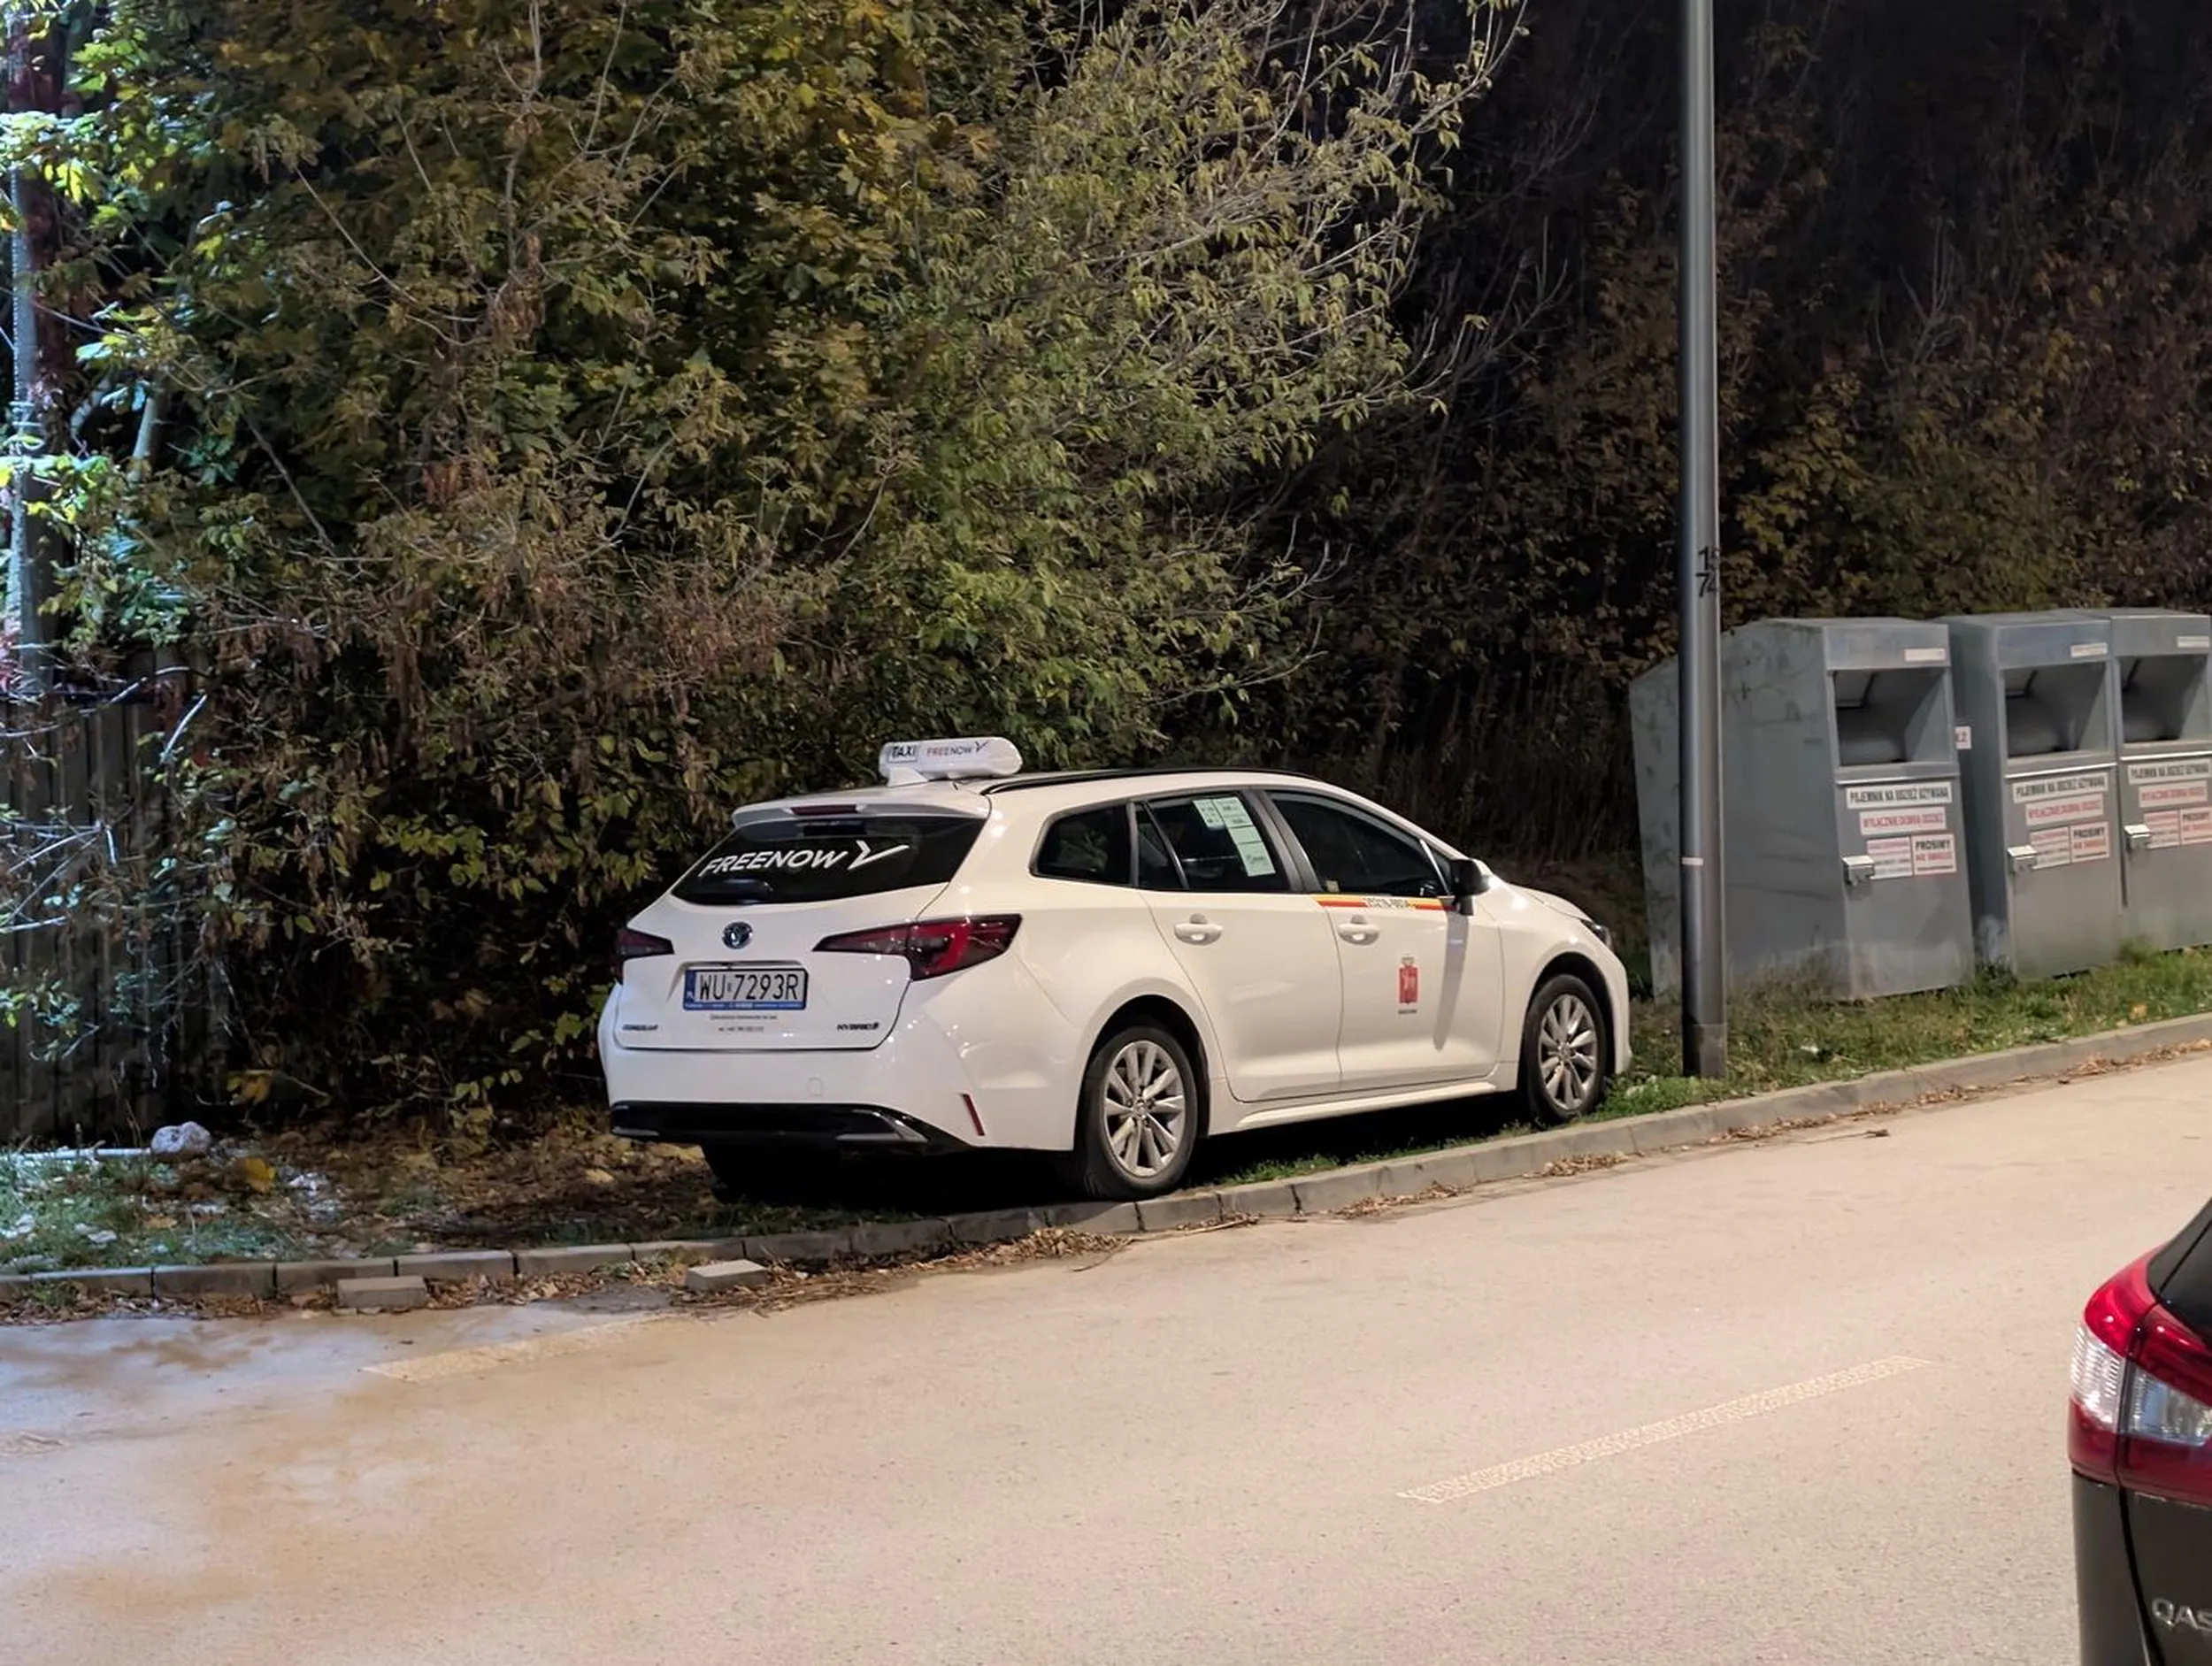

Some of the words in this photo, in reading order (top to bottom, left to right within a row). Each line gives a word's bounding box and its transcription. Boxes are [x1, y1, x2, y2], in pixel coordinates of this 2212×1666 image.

[892, 745, 916, 758] TAXI
[926, 747, 972, 756] FREENOW
[698, 849, 849, 877] FREENOW
[699, 974, 726, 1001] WU
[733, 973, 800, 1001] 7293R
